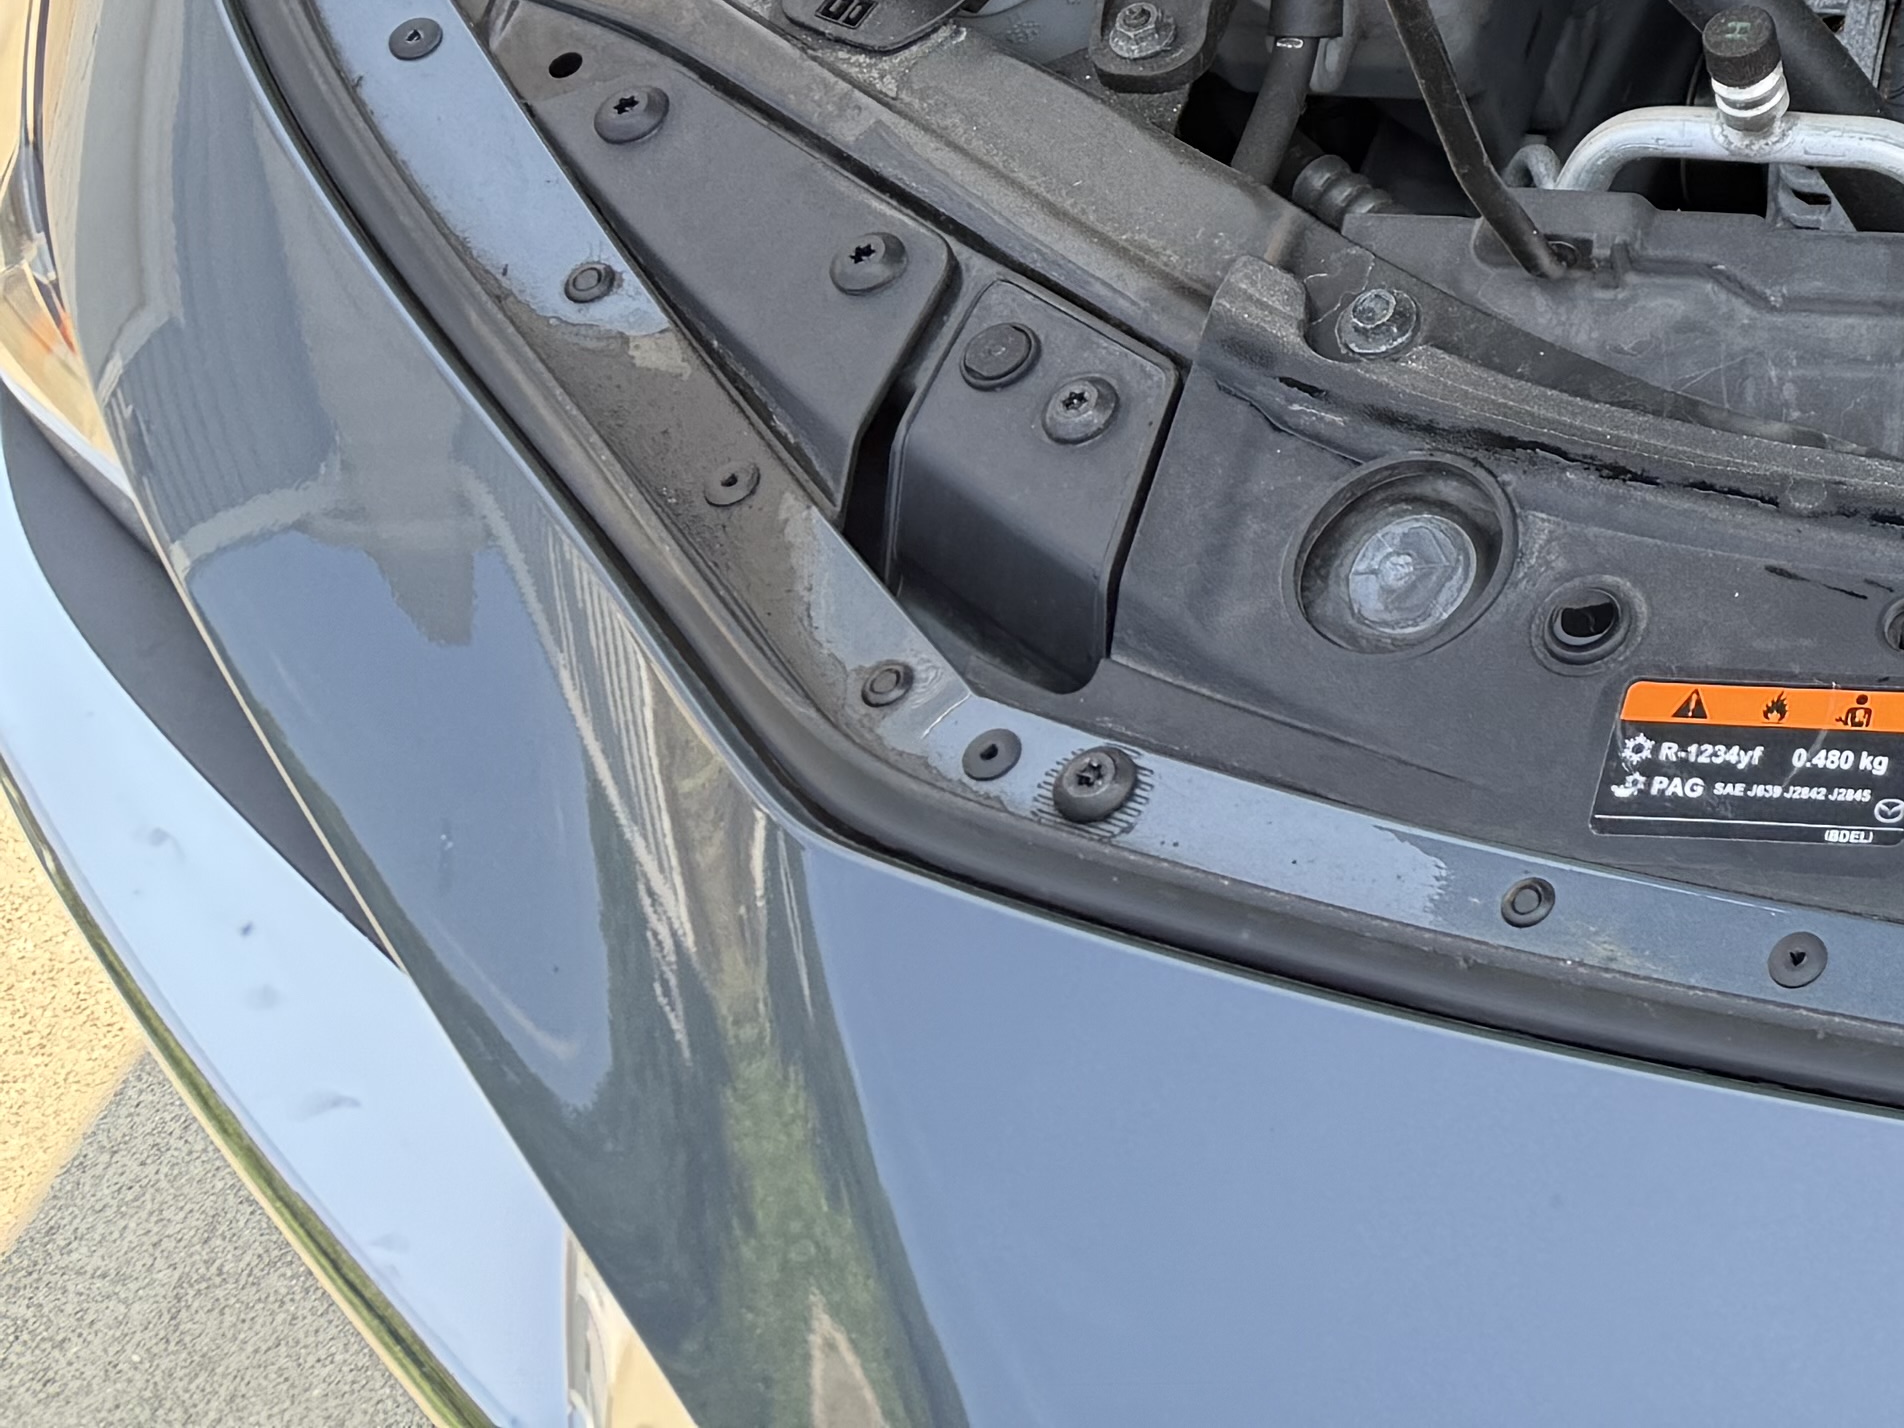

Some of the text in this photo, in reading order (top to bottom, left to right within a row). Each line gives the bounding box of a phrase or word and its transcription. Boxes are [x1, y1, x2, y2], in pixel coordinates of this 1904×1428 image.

[1658, 741, 1890, 776] R-1234yf 0.480 kg
[1650, 775, 1706, 799] PAG
[1713, 782, 1746, 797] SAE
[1828, 787, 1873, 803] J2845
[1824, 829, 1874, 845] (BDEL)
